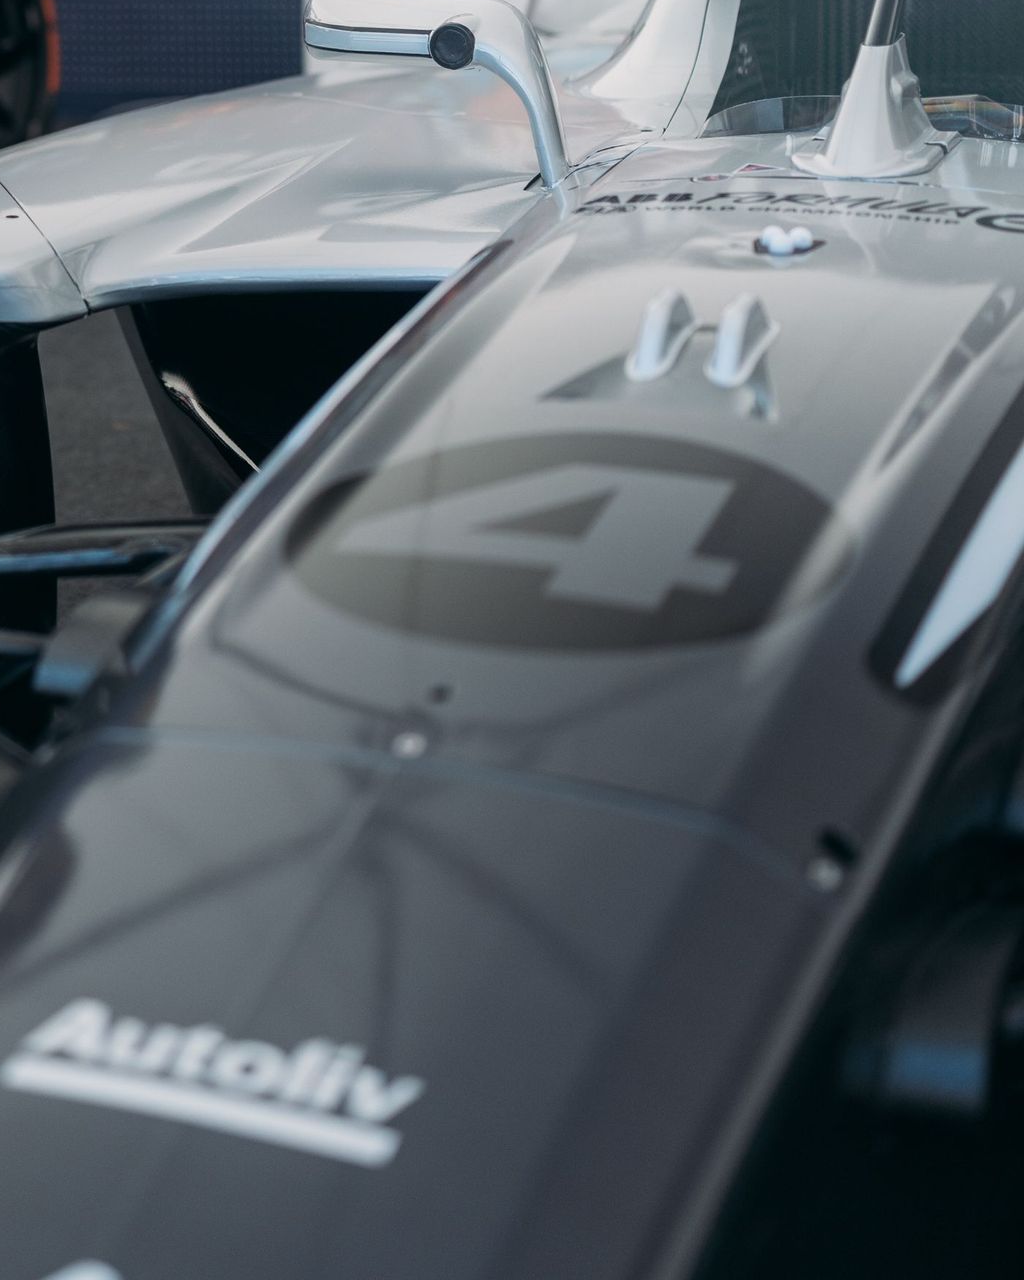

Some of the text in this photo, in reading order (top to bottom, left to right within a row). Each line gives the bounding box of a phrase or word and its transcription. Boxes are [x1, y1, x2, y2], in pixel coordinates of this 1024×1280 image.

[584, 191, 991, 219] ABB FORMULA
[334, 461, 738, 613] 4
[22, 996, 426, 1122] Autoliv
